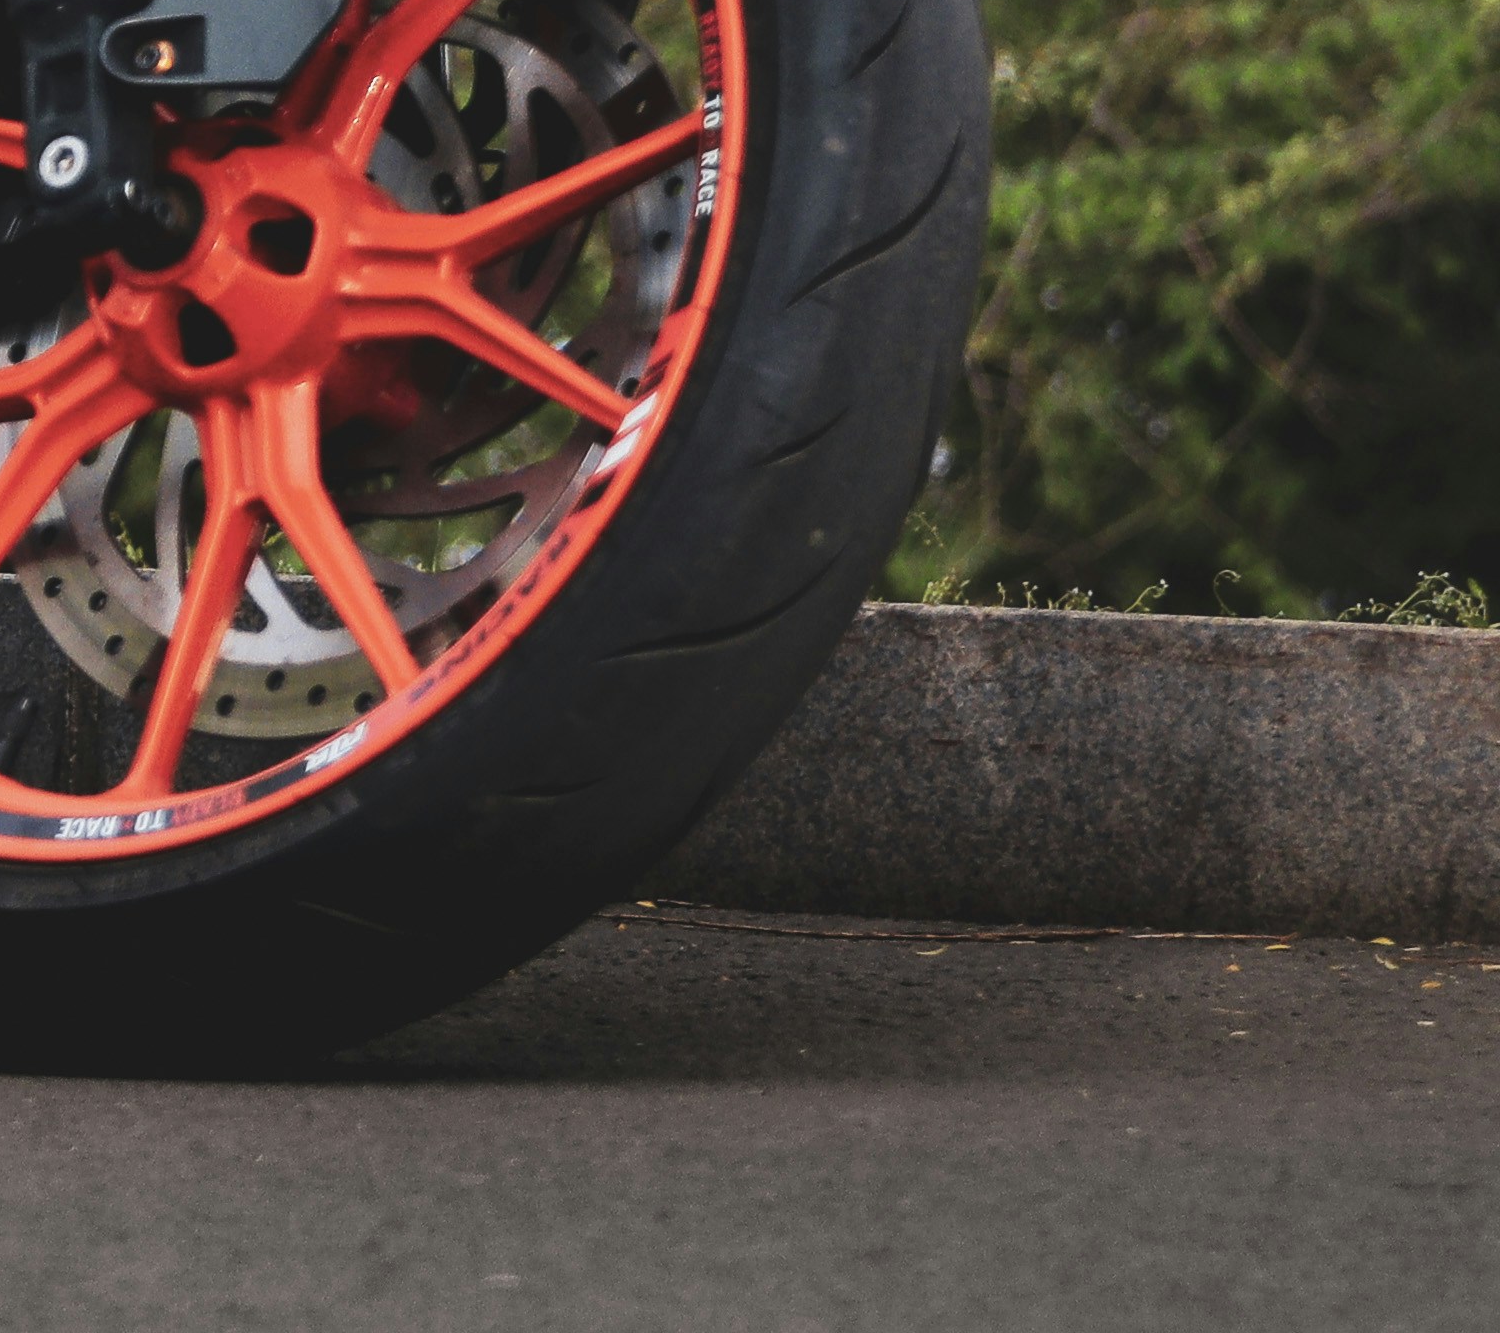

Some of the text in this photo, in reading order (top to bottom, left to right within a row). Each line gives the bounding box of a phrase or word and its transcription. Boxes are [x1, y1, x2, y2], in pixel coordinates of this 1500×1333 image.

[703, 93, 723, 130] TO
[694, 147, 719, 218] RACE
[54, 815, 120, 841] RACE
